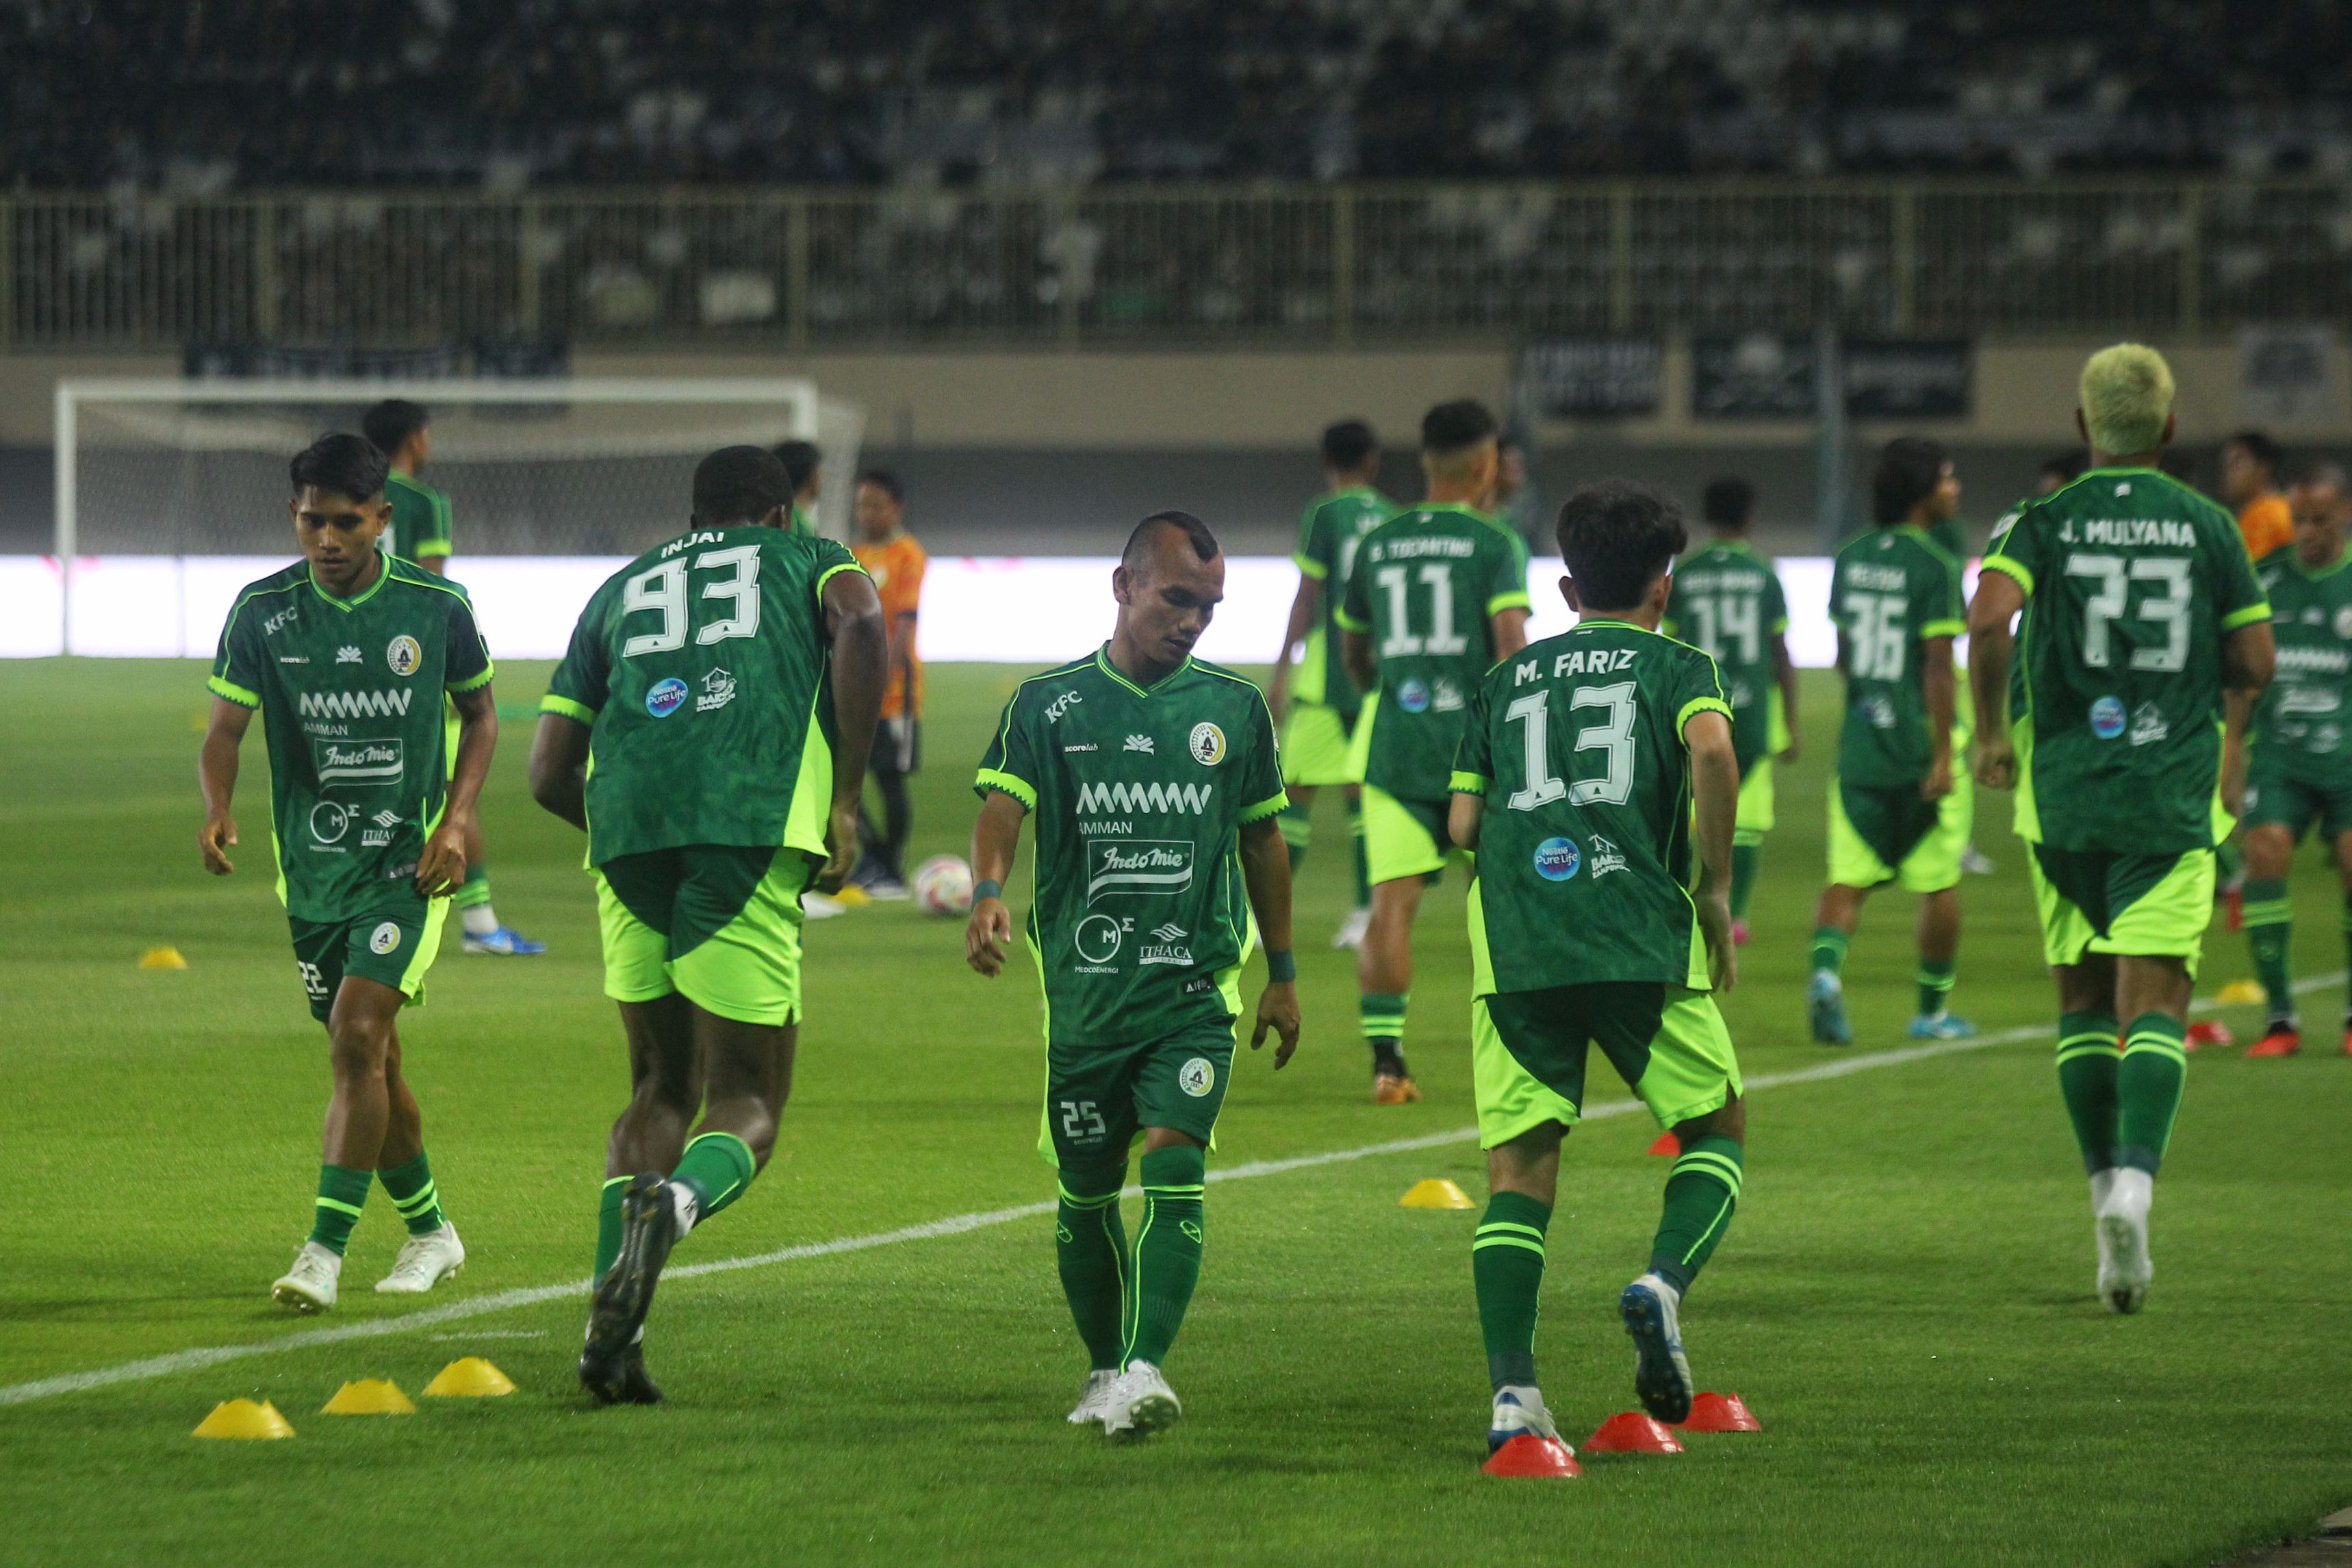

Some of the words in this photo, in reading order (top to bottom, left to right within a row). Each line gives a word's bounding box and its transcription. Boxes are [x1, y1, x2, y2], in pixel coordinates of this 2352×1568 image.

[661, 531, 725, 558] INJAI
[2085, 519, 2197, 548] MULYANA
[622, 544, 762, 658] 93
[1377, 565, 1469, 658] 11
[2064, 553, 2194, 673] 73
[264, 606, 298, 636] KFC
[1688, 596, 1762, 665] 14
[1515, 659, 1543, 686] M.
[1553, 648, 1639, 678] FARIZ
[647, 693, 670, 706] Pure
[670, 689, 687, 702] Life
[1045, 691, 1083, 724] KFC
[304, 722, 349, 736] AMMAN
[1064, 743, 1099, 752] scorelab
[1505, 681, 1638, 811] 13
[1079, 821, 1133, 834] AMMAN
[1535, 856, 1561, 865] Pure
[1561, 853, 1578, 866] Life
[1139, 944, 1192, 959] ITHACA
[298, 960, 329, 994] 22
[1060, 1101, 1106, 1138] 25
